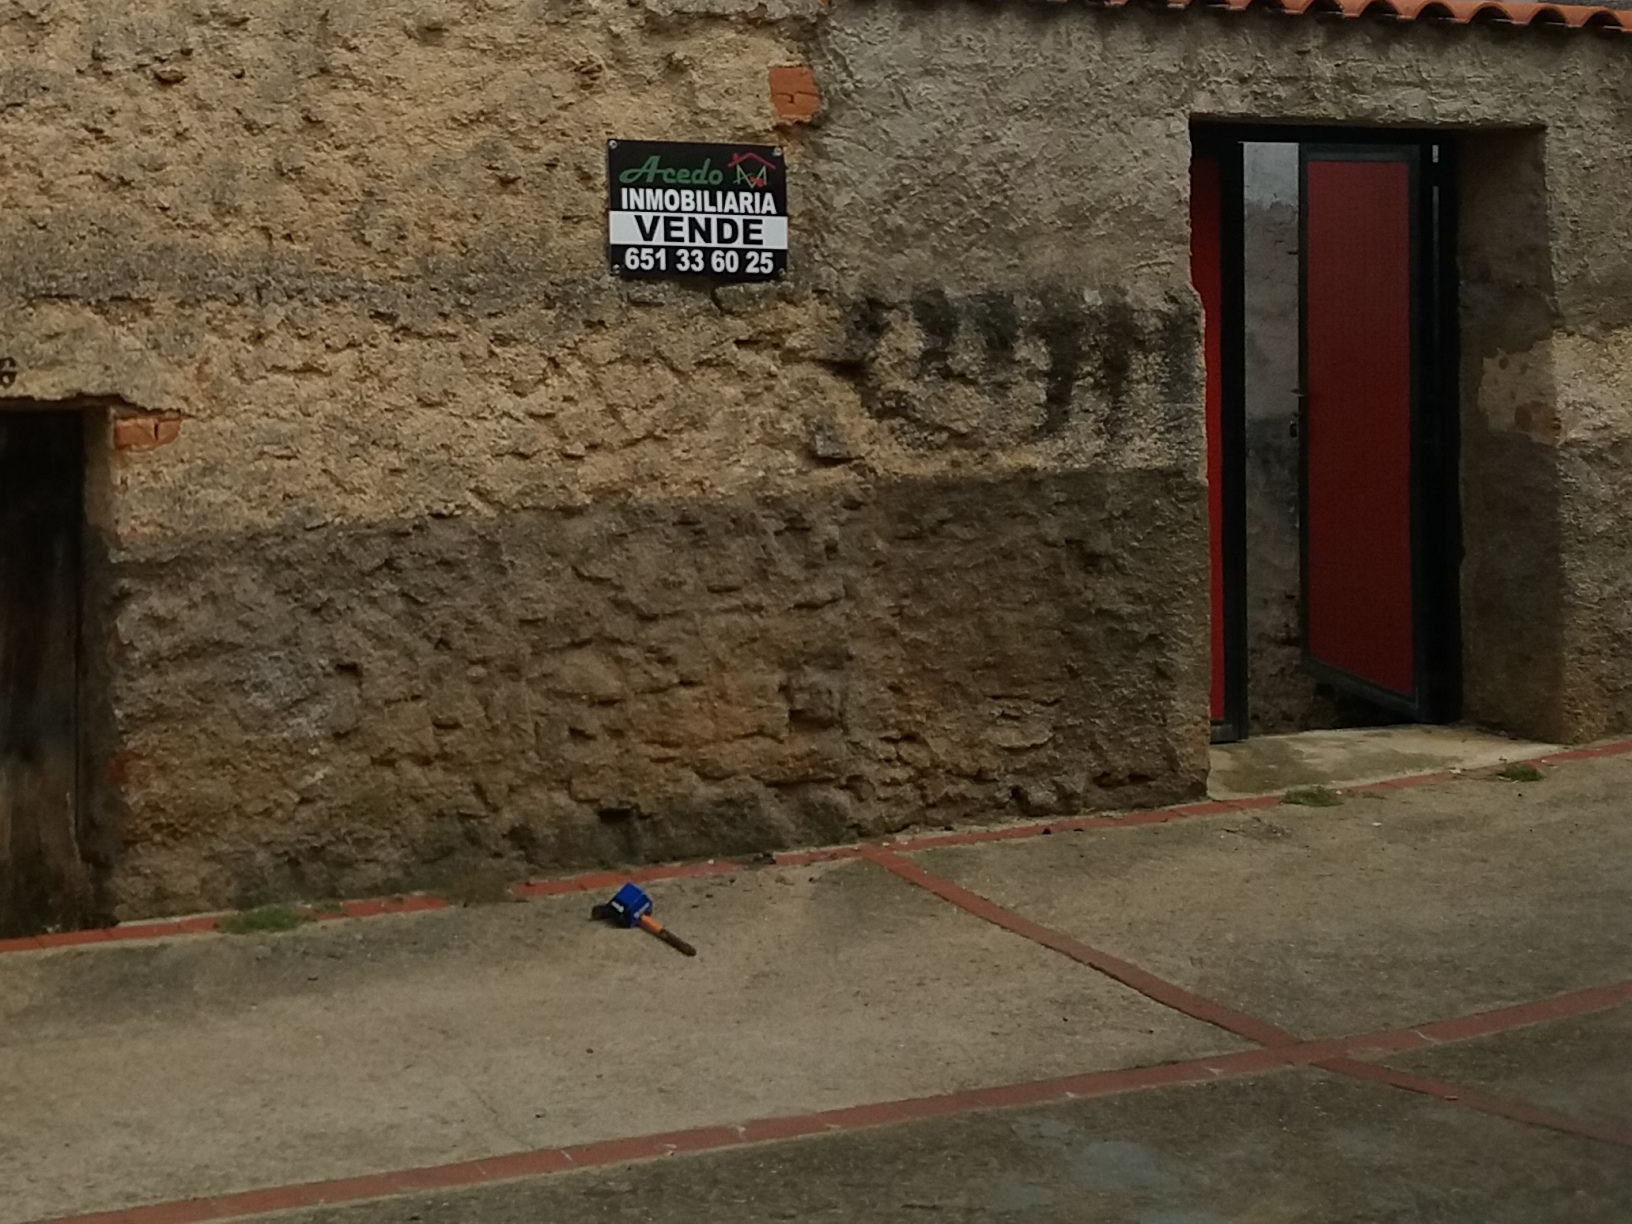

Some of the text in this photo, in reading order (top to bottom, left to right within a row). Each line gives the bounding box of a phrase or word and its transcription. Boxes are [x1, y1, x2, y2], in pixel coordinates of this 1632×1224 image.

[619, 155, 724, 185] Acedo
[621, 187, 777, 214] INMOBILIARIA
[634, 214, 764, 246] VENDE
[624, 247, 774, 274] 651 33 60 25
